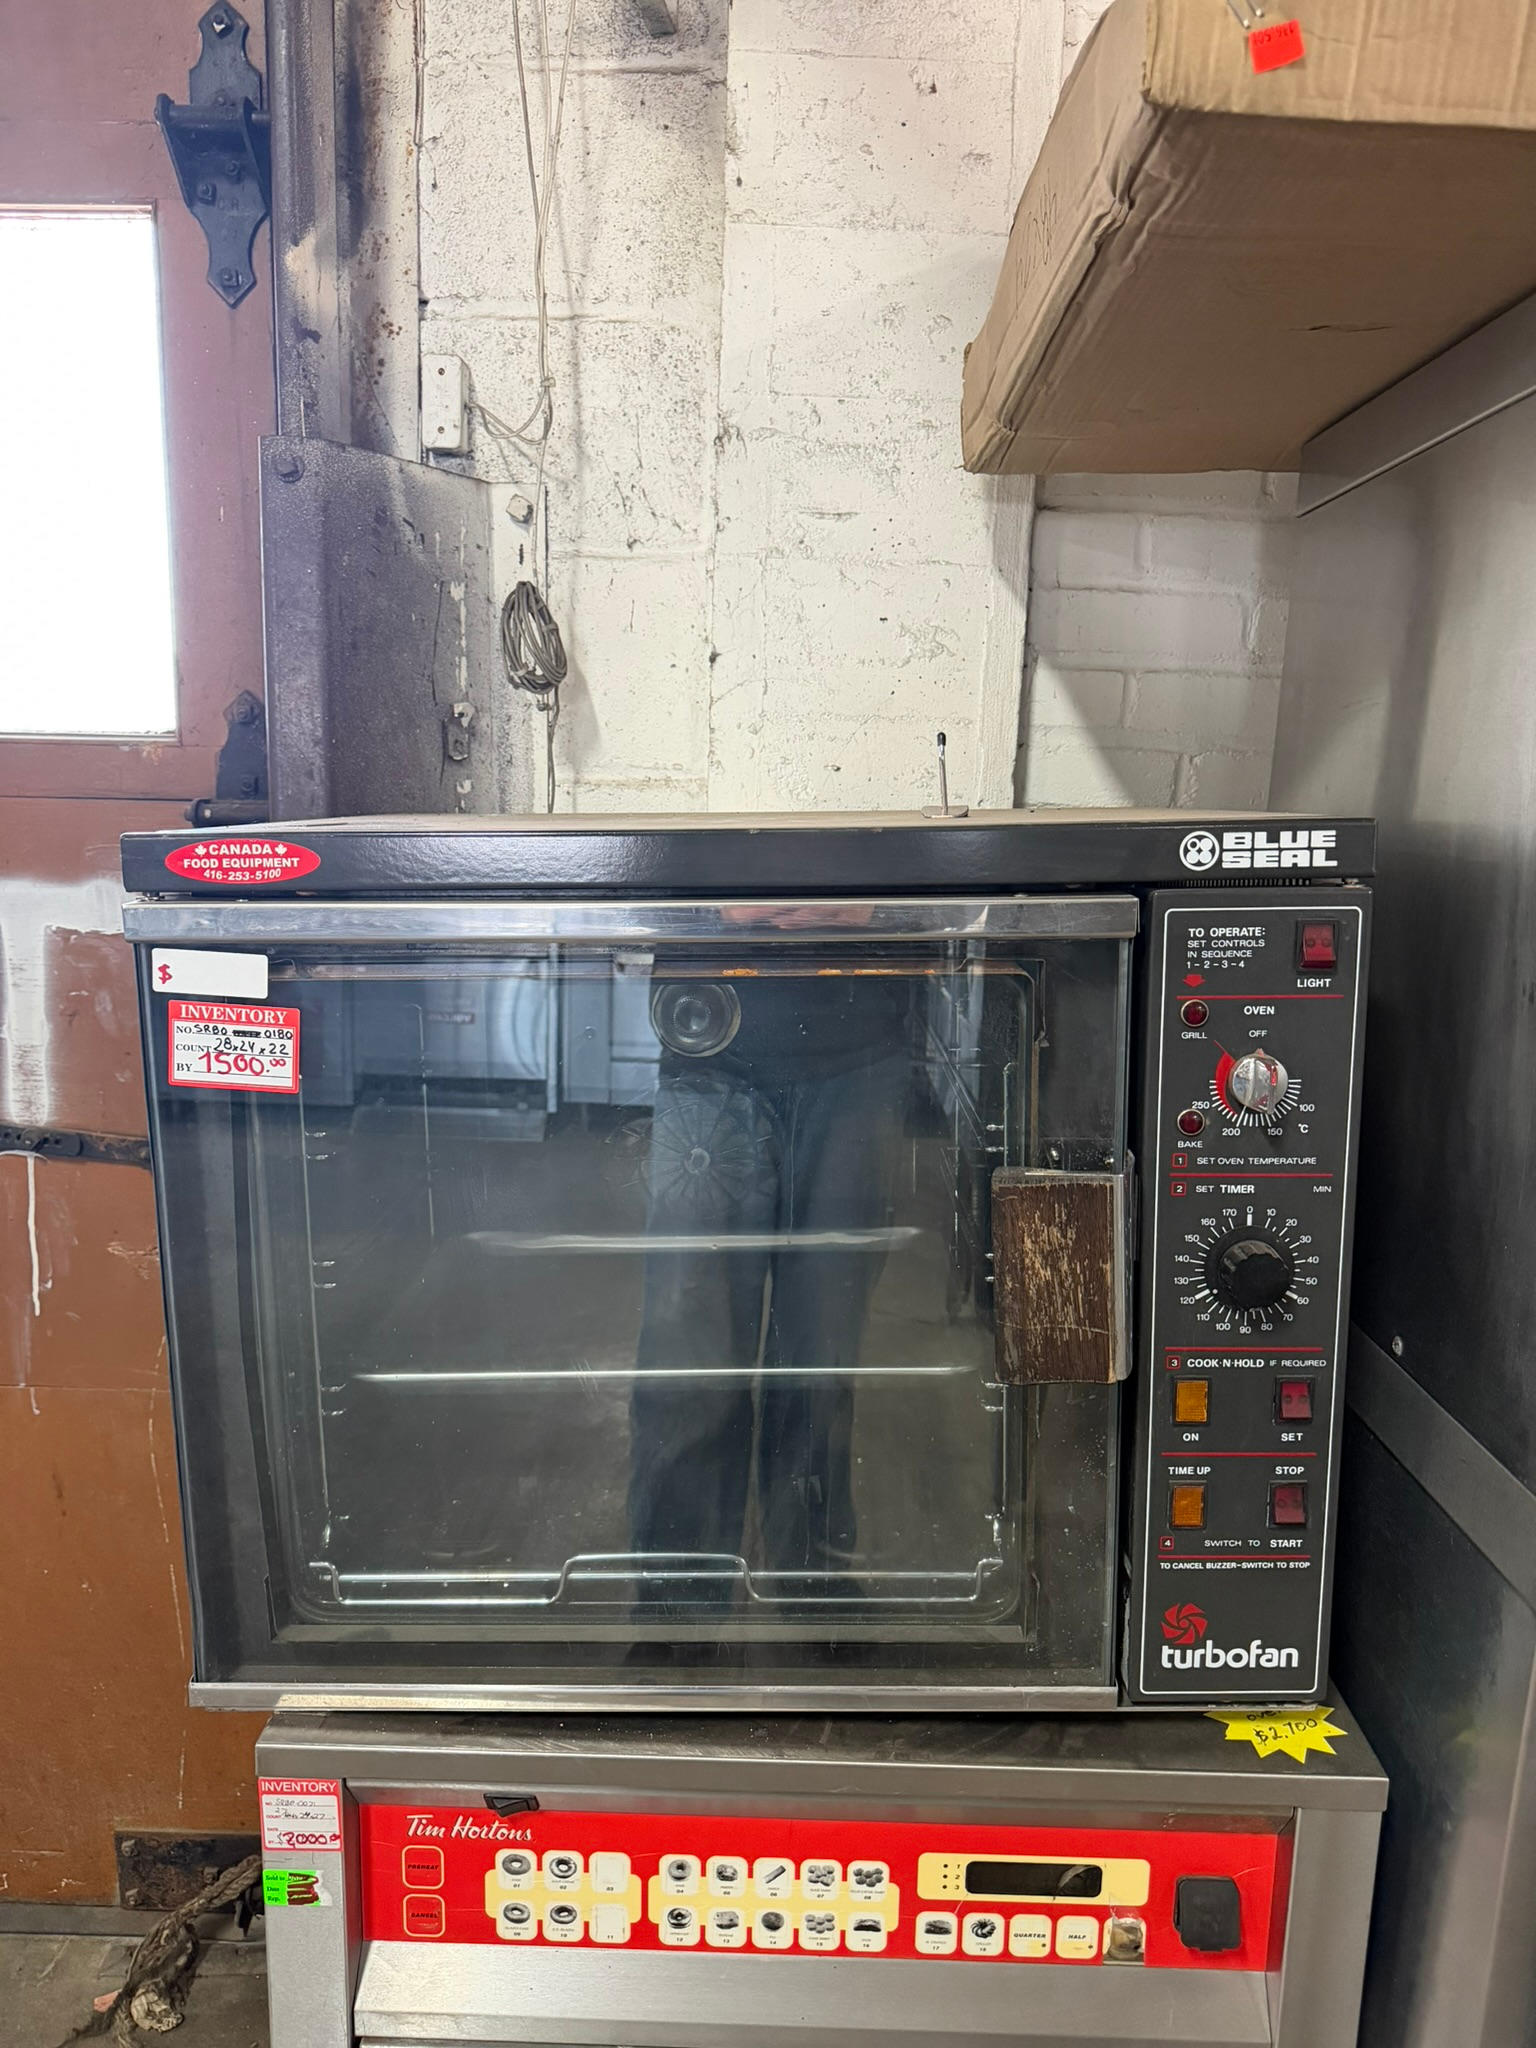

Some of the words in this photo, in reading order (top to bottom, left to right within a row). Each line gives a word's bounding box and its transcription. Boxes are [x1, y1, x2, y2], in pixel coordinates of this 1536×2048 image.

[1222, 830, 1337, 849] BLUE
[209, 844, 273, 855] CANADA
[183, 859, 219, 869] FOOD
[222, 857, 300, 868] EQUIPMENT
[1222, 849, 1338, 869] SEAL
[203, 869, 281, 881] 416-253-5100
[1188, 928, 1204, 937] TO
[1210, 927, 1266, 937] OPERATE:
[1187, 940, 1206, 948] SET
[1211, 939, 1265, 948] CONTROLS
[1187, 950, 1197, 958] IN
[1201, 950, 1252, 958] SEQUENCE
[158, 964, 173, 984] $
[1297, 978, 1332, 988] LIGHT
[180, 1004, 287, 1024] INVENTORY
[1243, 1006, 1275, 1015] OVEN
[1249, 1030, 1268, 1038] OFF
[176, 1044, 212, 1052] COUNT
[176, 1063, 192, 1072] BY
[1192, 1101, 1210, 1109] 250
[1299, 1104, 1315, 1112] 100
[1222, 1128, 1240, 1136] 200
[1267, 1128, 1283, 1136] 150
[1197, 1157, 1215, 1165] SET
[1217, 1157, 1244, 1165] OVEN
[1248, 1157, 1317, 1165] TEMPERATURE
[1176, 1185, 1183, 1193] 2
[1196, 1185, 1214, 1193] SET
[1220, 1185, 1255, 1194] TIMER
[1313, 1185, 1332, 1193] MIN
[1222, 1208, 1237, 1217] 170
[1246, 1205, 1253, 1214] 0
[1267, 1208, 1276, 1217] 10
[1200, 1218, 1216, 1226] 160
[1286, 1218, 1297, 1227] 20
[1184, 1234, 1200, 1243] 150
[1300, 1235, 1312, 1244] 30
[1174, 1255, 1190, 1263] 140
[1307, 1255, 1319, 1264] 40
[1174, 1276, 1189, 1285] 130
[1306, 1277, 1317, 1286] 50
[1180, 1296, 1195, 1305] 120
[1297, 1296, 1309, 1305] 60
[1197, 1313, 1210, 1322] 110
[1282, 1313, 1293, 1322] 70
[1216, 1322, 1231, 1331] 100
[1239, 1325, 1251, 1334] 90
[1261, 1323, 1273, 1331] 80
[1183, 1433, 1199, 1442] ON
[1281, 1433, 1304, 1442] SET
[1168, 1467, 1195, 1475] TIME
[1196, 1467, 1211, 1475] UP
[1275, 1466, 1305, 1475] STOP
[1204, 1539, 1242, 1547] SWITCH
[1248, 1539, 1261, 1547] TO
[1270, 1539, 1303, 1548] START
[1161, 1640, 1299, 1669] turbofan
[261, 1781, 337, 1792] INVENTORY
[406, 1814, 446, 1838] Tim
[450, 1815, 532, 1841] Hortons
